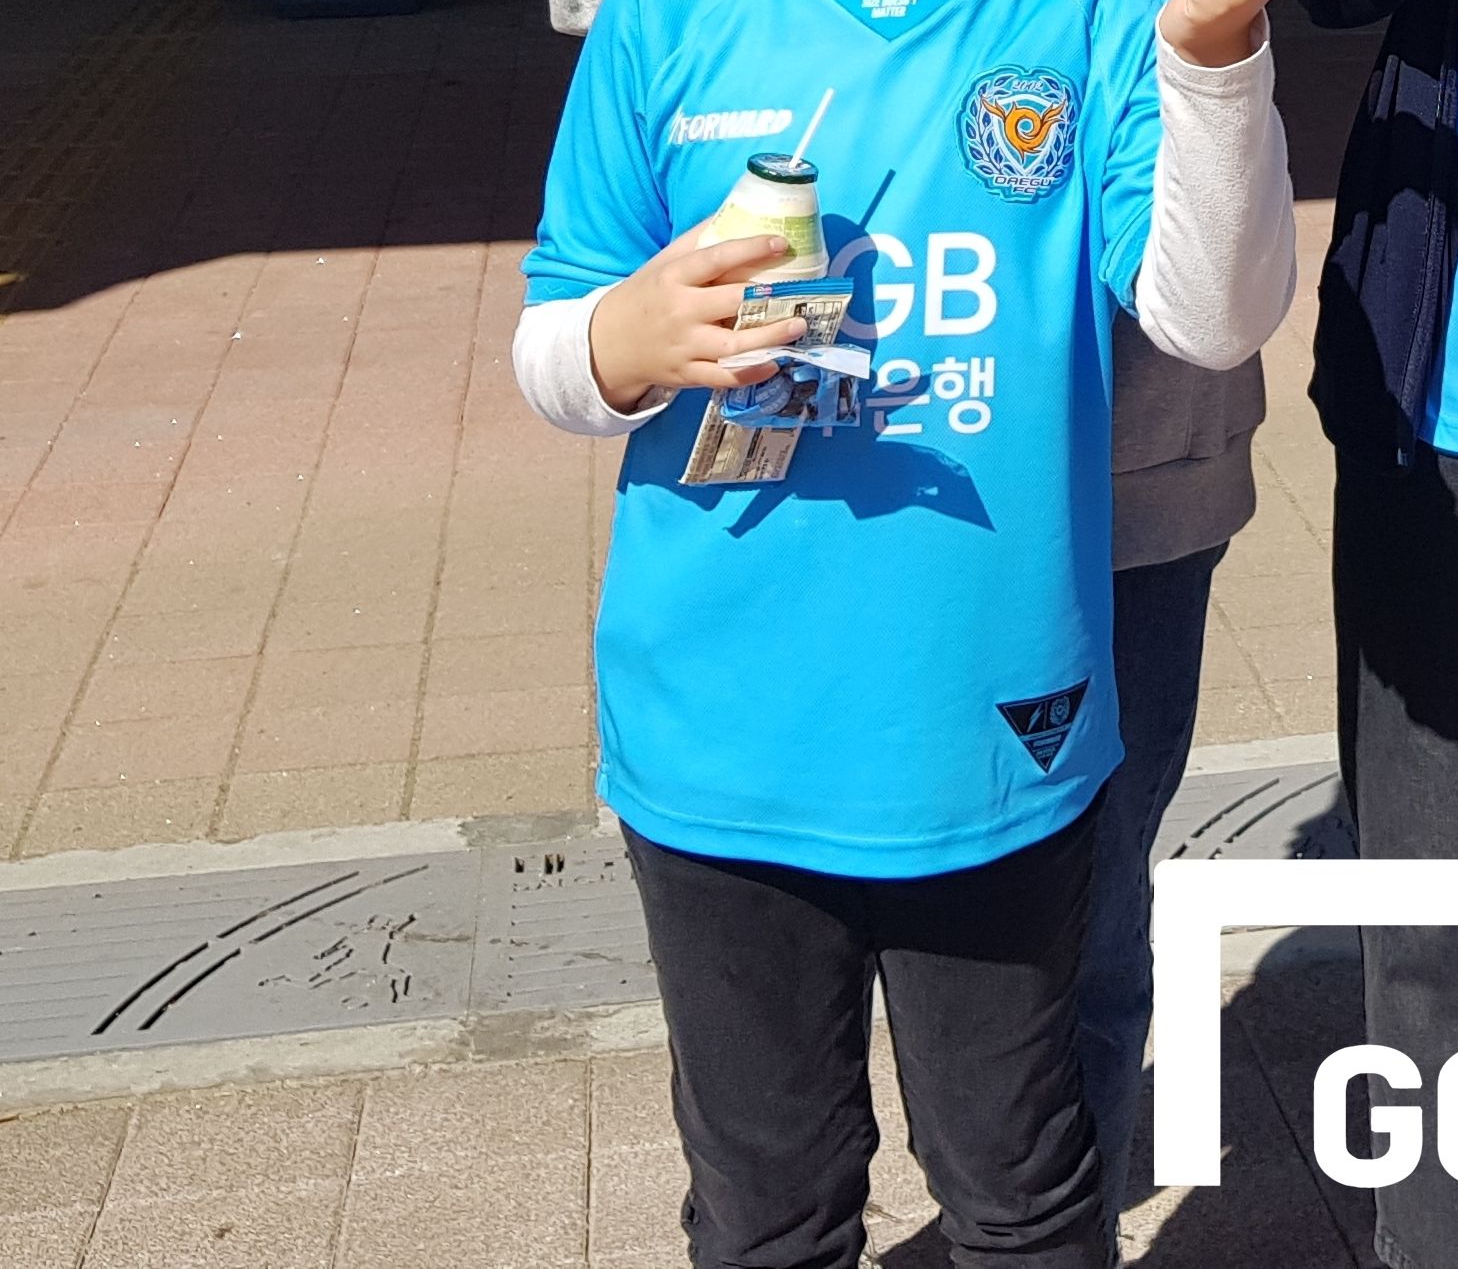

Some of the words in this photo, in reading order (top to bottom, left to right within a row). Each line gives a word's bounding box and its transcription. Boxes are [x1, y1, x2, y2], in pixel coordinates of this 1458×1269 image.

[1011, 80, 1045, 92] 2002
[994, 175, 1052, 187] DAEGU
[1012, 186, 1037, 194] FC
[827, 231, 998, 340] GB
[822, 355, 996, 438] 은행
